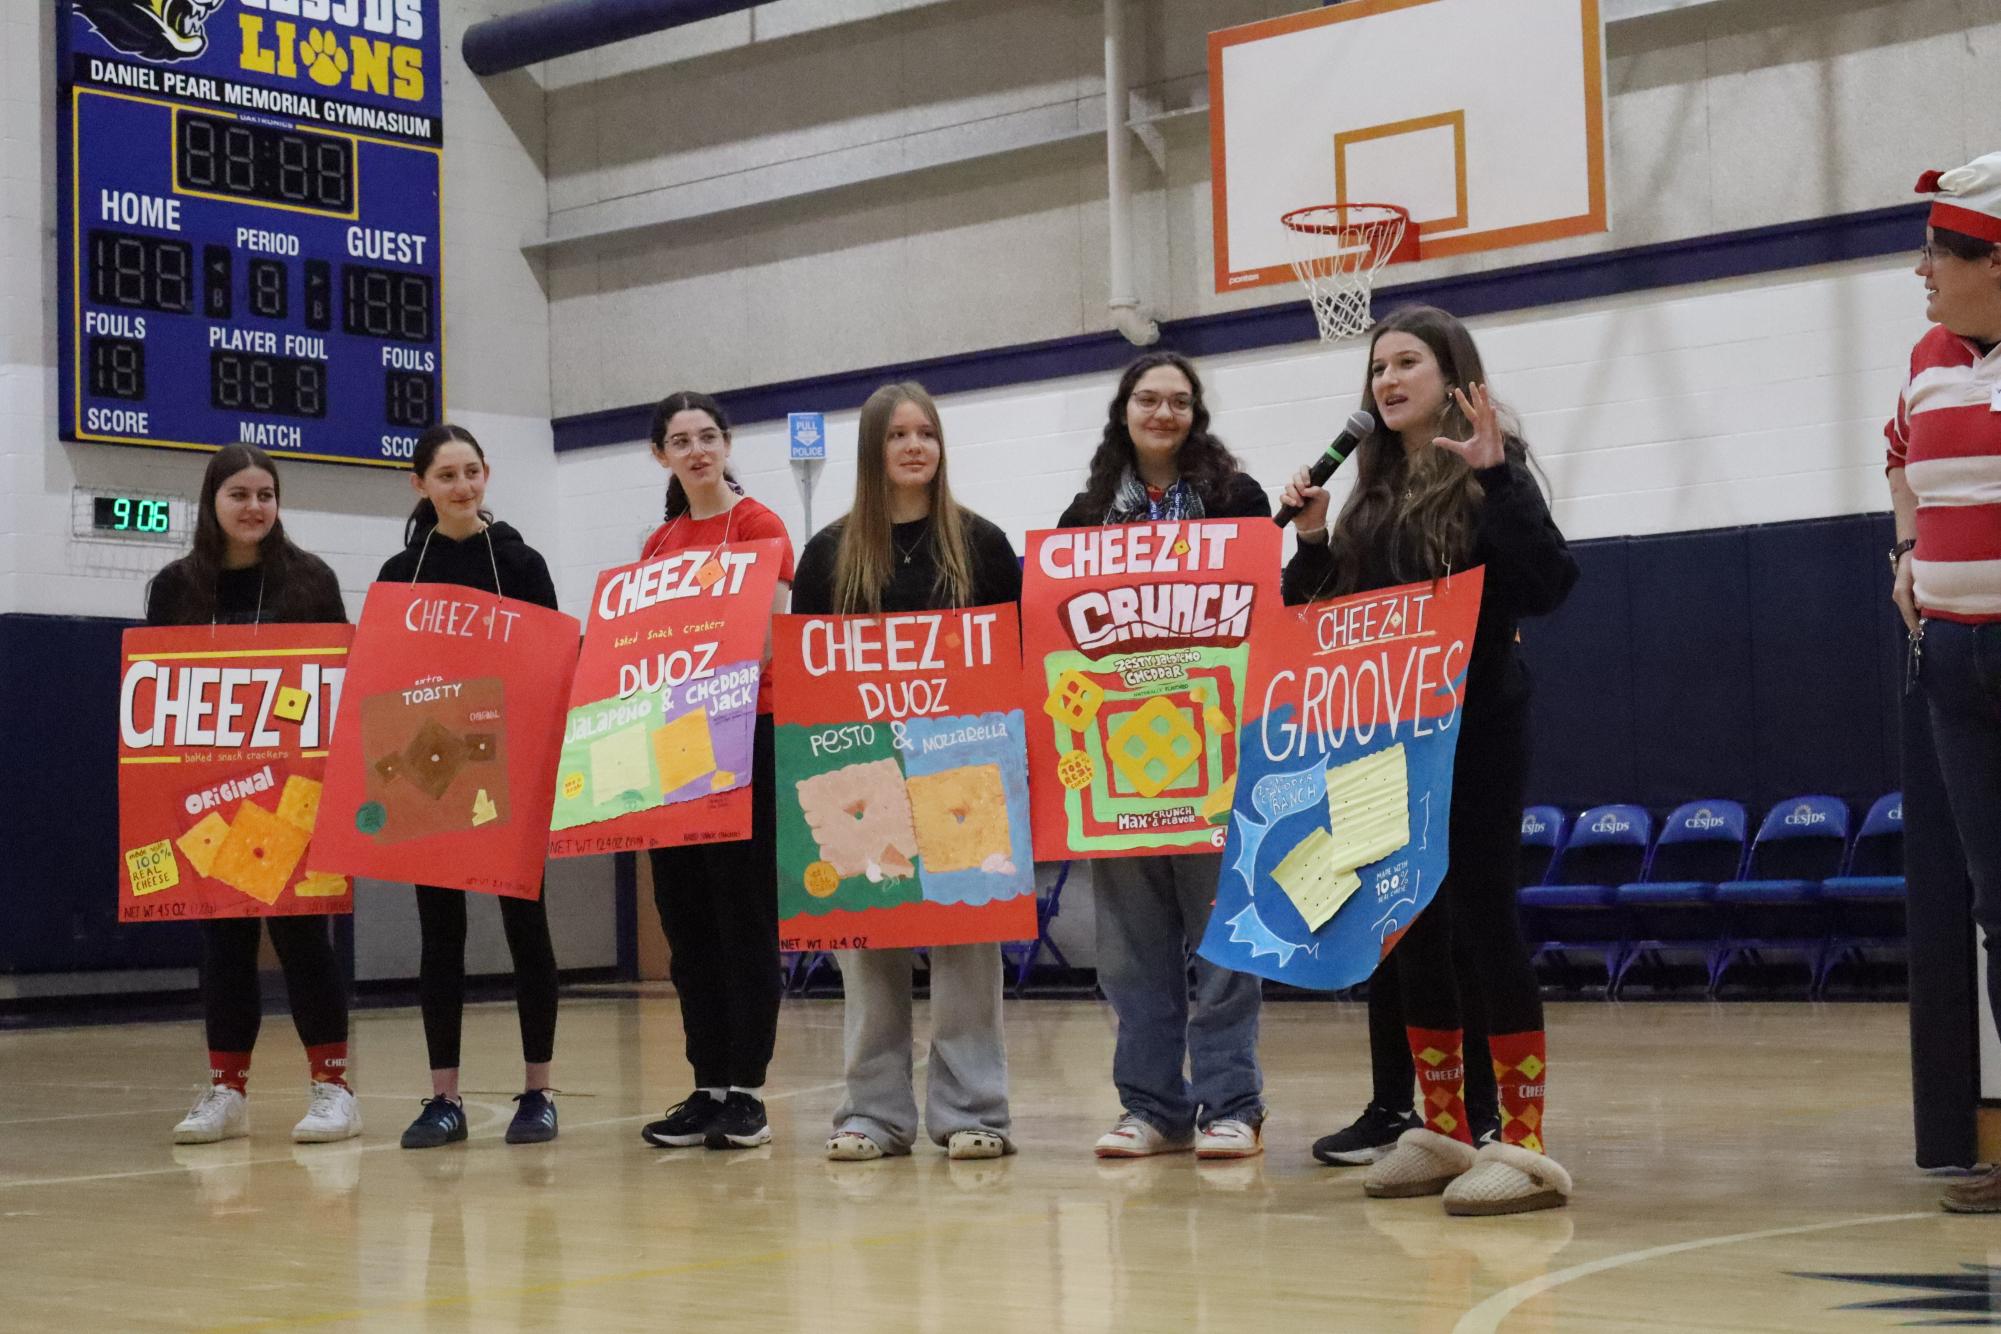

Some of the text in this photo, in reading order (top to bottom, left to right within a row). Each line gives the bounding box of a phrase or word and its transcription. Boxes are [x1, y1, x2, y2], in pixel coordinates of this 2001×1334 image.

[91, 60, 430, 138] DANIEL PEARL MEMORIAL GYMNASIUM
[102, 189, 181, 230] HOME
[237, 228, 299, 256] PERIOD
[347, 226, 426, 264] GUEST
[86, 312, 146, 339] FOULS
[209, 327, 328, 360] PLAYER FOUL
[382, 346, 434, 372] FOULS
[88, 408, 149, 434] SCORE
[796, 420, 817, 430] PULL
[240, 421, 301, 448] MATCH
[381, 435, 419, 458] SCO
[792, 446, 823, 457] POLICE
[614, 632, 638, 648] baked
[415, 674, 444, 686] extra
[619, 641, 719, 700] DUOZ
[661, 687, 675, 713] &
[858, 678, 949, 719] DUOZ
[1261, 640, 1465, 762] GROOVES
[890, 720, 914, 751] &
[218, 751, 243, 762] snack
[246, 750, 289, 760] crackers
[1152, 806, 1193, 819] CRUNCH
[1273, 783, 1317, 817] RANCH
[136, 847, 172, 870] 100%
[549, 839, 573, 855] NET
[575, 838, 593, 854] WT
[132, 865, 162, 881] REAL
[136, 872, 170, 891] CHEESE
[781, 938, 800, 950] NET
[807, 938, 822, 950] WT
[853, 935, 868, 949] OZ
